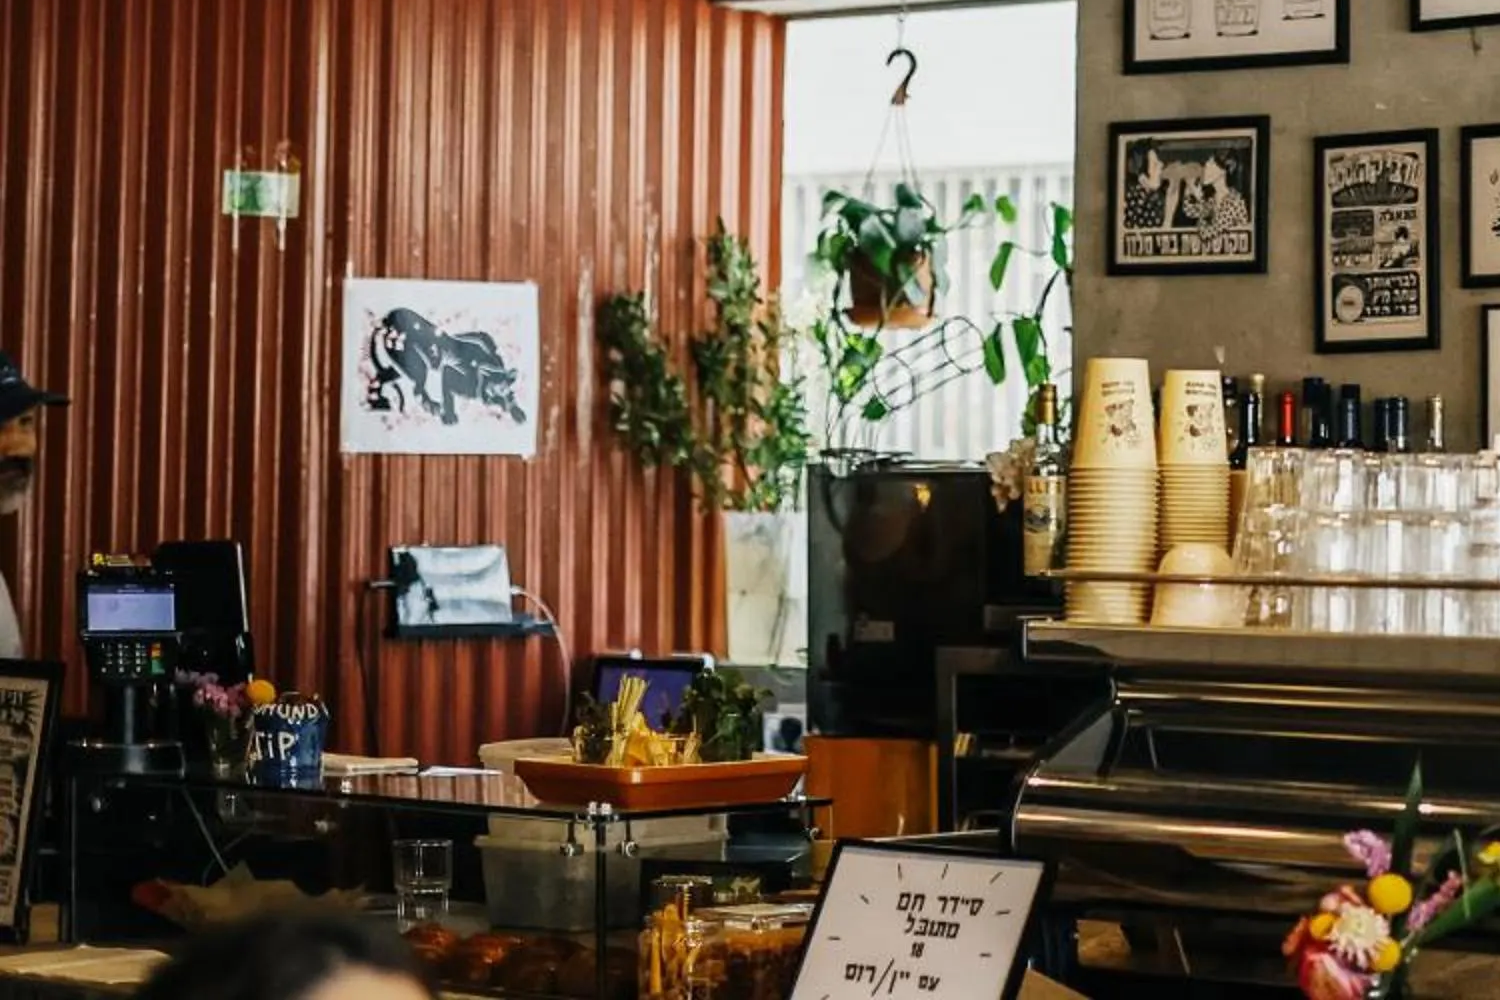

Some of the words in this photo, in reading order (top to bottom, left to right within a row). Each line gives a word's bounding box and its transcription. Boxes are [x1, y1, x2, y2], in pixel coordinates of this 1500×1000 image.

[895, 891, 927, 913] חם
[936, 895, 985, 917] סיידר
[904, 912, 961, 940] מתובל
[910, 940, 926, 958] 18
[918, 974, 941, 992] עם
